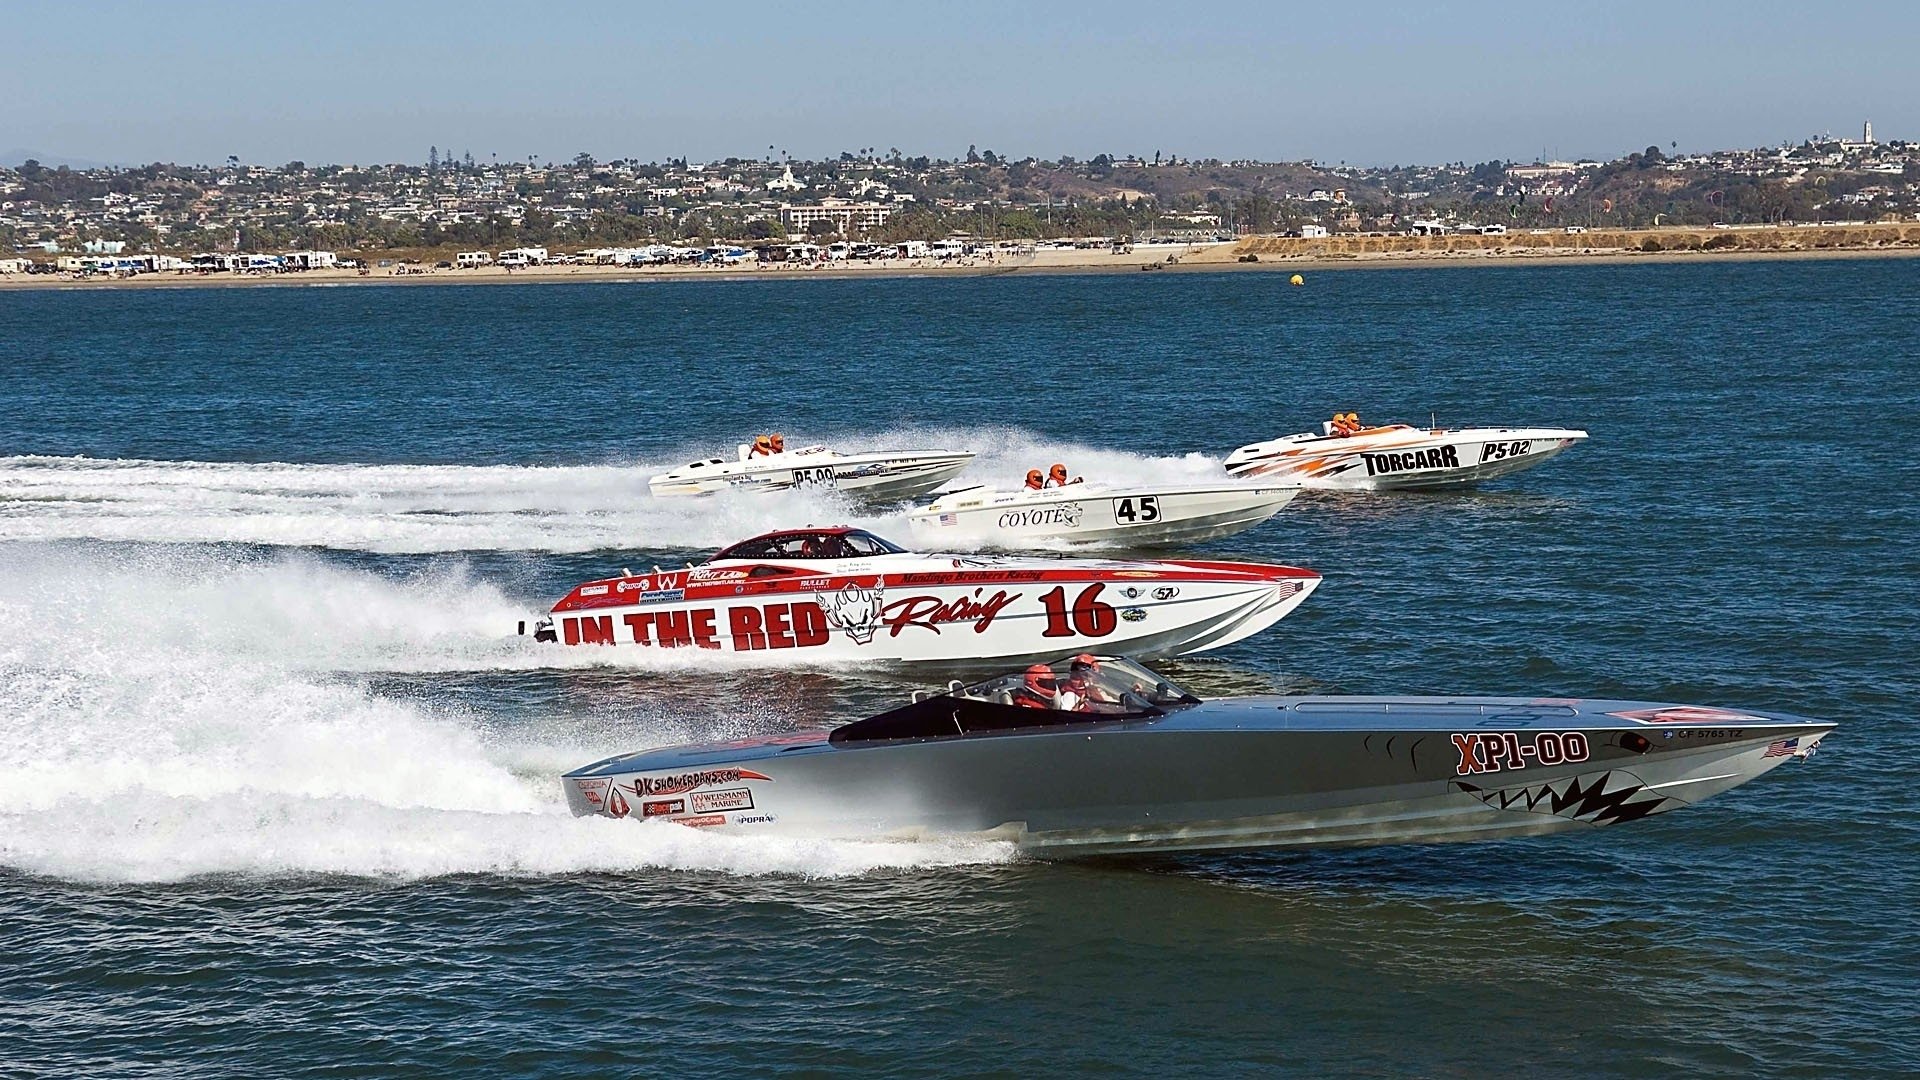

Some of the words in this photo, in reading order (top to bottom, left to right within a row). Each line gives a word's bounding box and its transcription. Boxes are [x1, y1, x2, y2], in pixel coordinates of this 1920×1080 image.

[1360, 444, 1460, 476] TORCARR
[998, 508, 1065, 528] COYOTE
[1117, 496, 1158, 522] 45
[901, 572, 953, 584] Mandingo
[954, 571, 1004, 582] Brothers
[1004, 570, 1045, 581] Racing
[881, 587, 1024, 637] Racing
[1037, 581, 1118, 637] 16
[562, 615, 617, 647] IN
[623, 608, 721, 650] THE
[728, 601, 830, 651] RED
[1678, 730, 1694, 739] CF
[1697, 730, 1725, 739] 5765
[1728, 729, 1744, 738] TZ
[1451, 731, 1590, 775] XP1-00
[704, 791, 749, 801] WEISMANN
[711, 799, 743, 808] MARINE
[741, 814, 771, 824] POPRA
